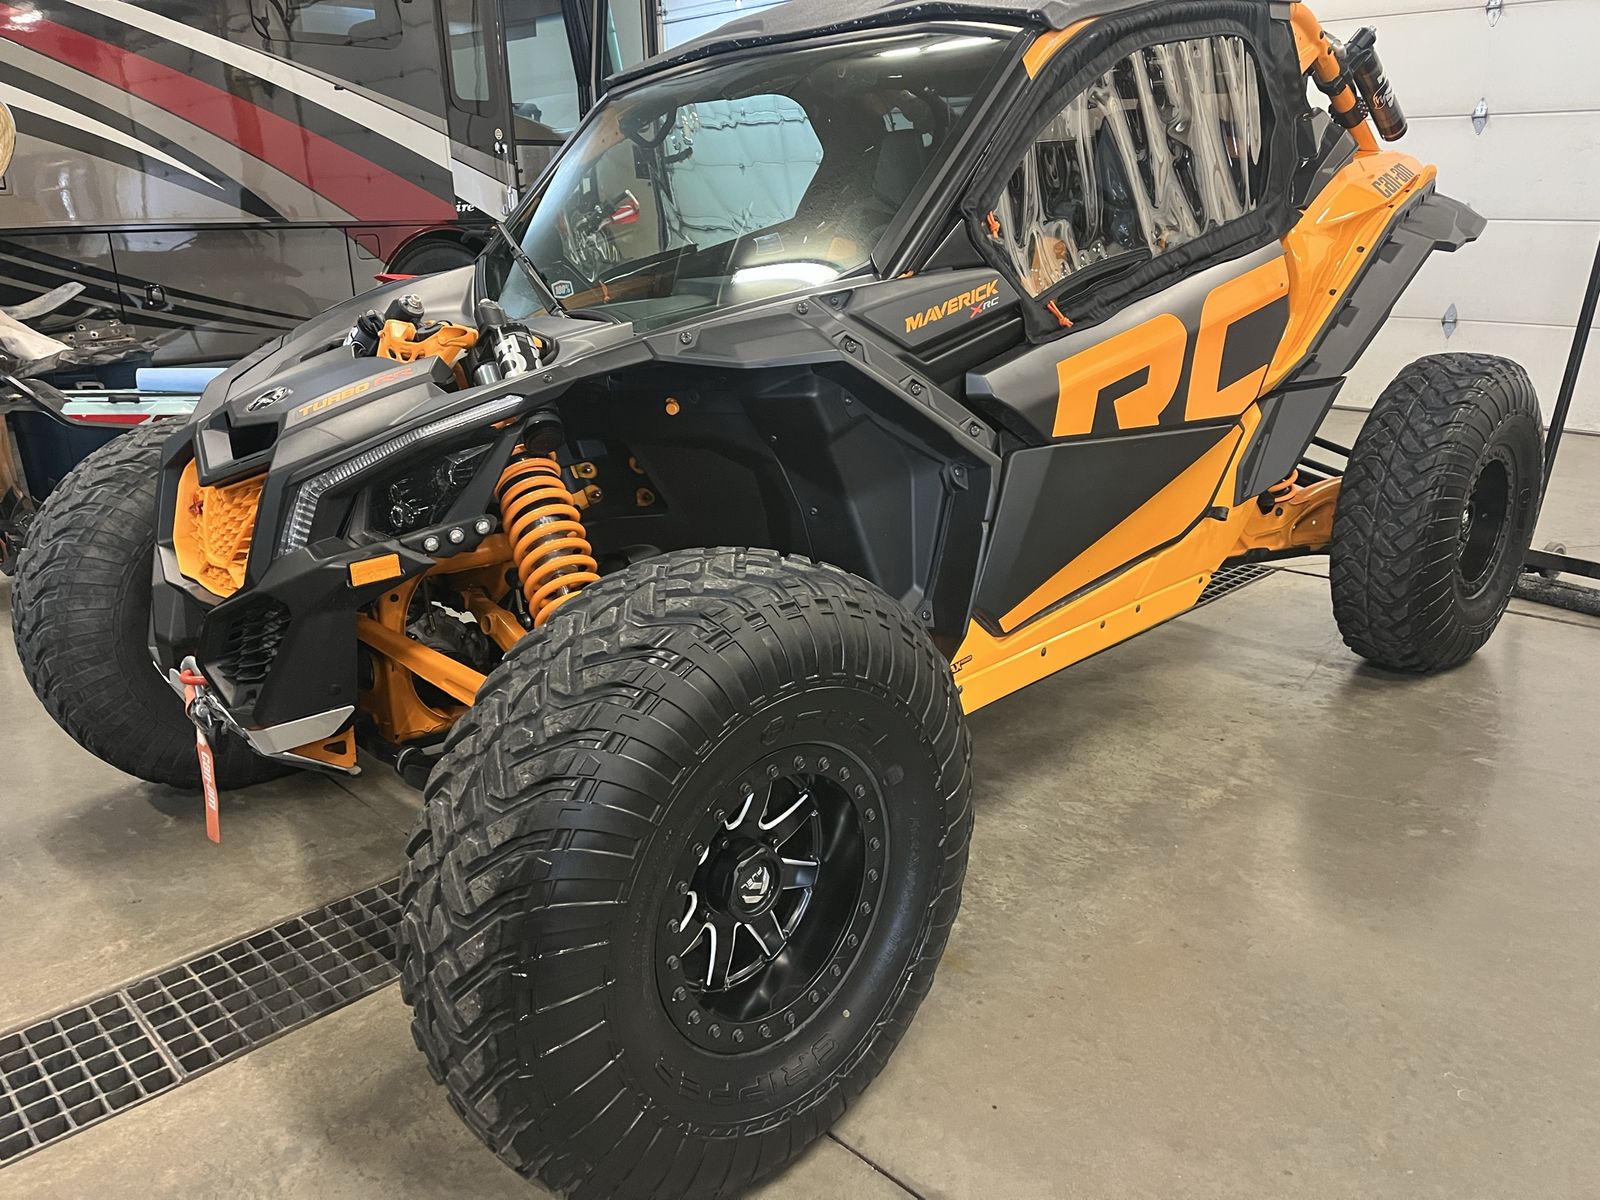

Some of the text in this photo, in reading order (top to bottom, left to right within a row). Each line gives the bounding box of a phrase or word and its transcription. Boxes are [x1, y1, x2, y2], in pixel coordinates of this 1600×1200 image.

[904, 279, 999, 333] MAVERICK
[1052, 255, 1290, 438] RC
[298, 382, 370, 417] TURBO
